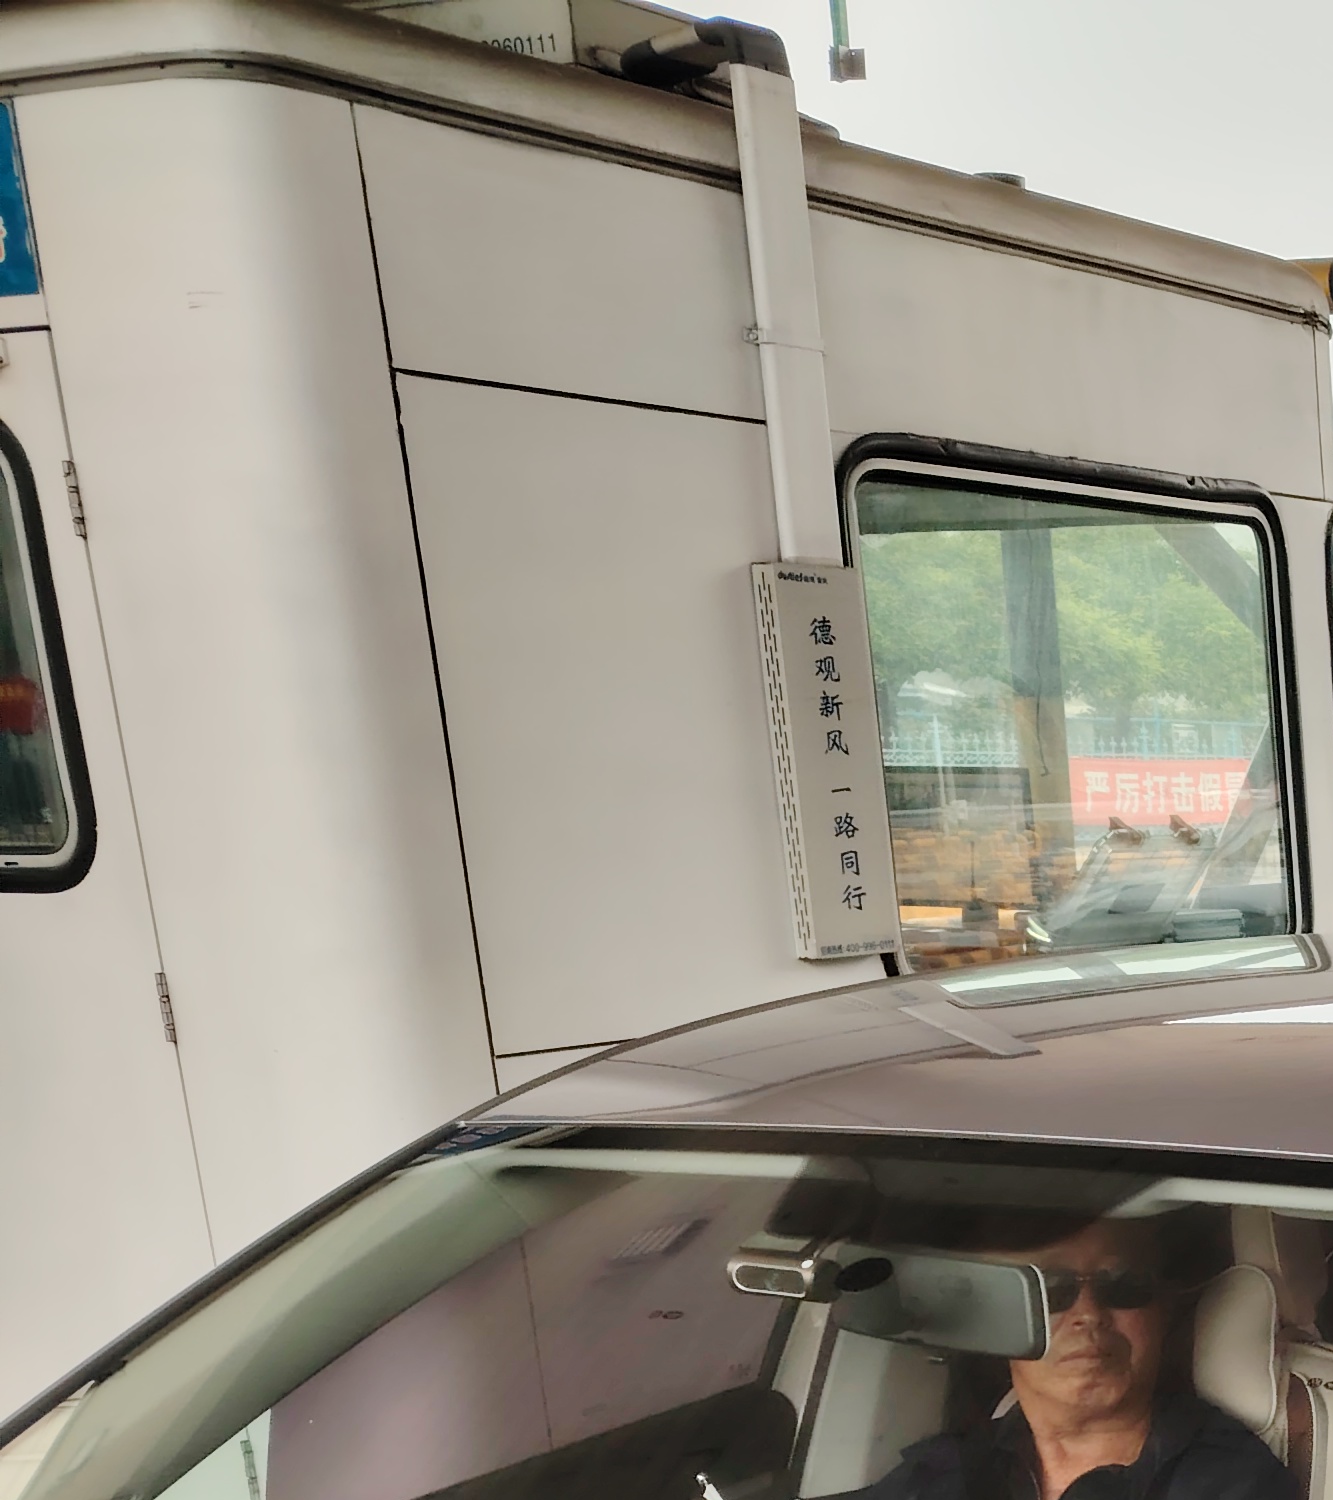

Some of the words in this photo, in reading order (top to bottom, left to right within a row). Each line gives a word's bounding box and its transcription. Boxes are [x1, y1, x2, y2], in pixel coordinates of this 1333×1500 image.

[809, 615, 850, 756] 德观新风
[831, 785, 867, 911] 一路同行
